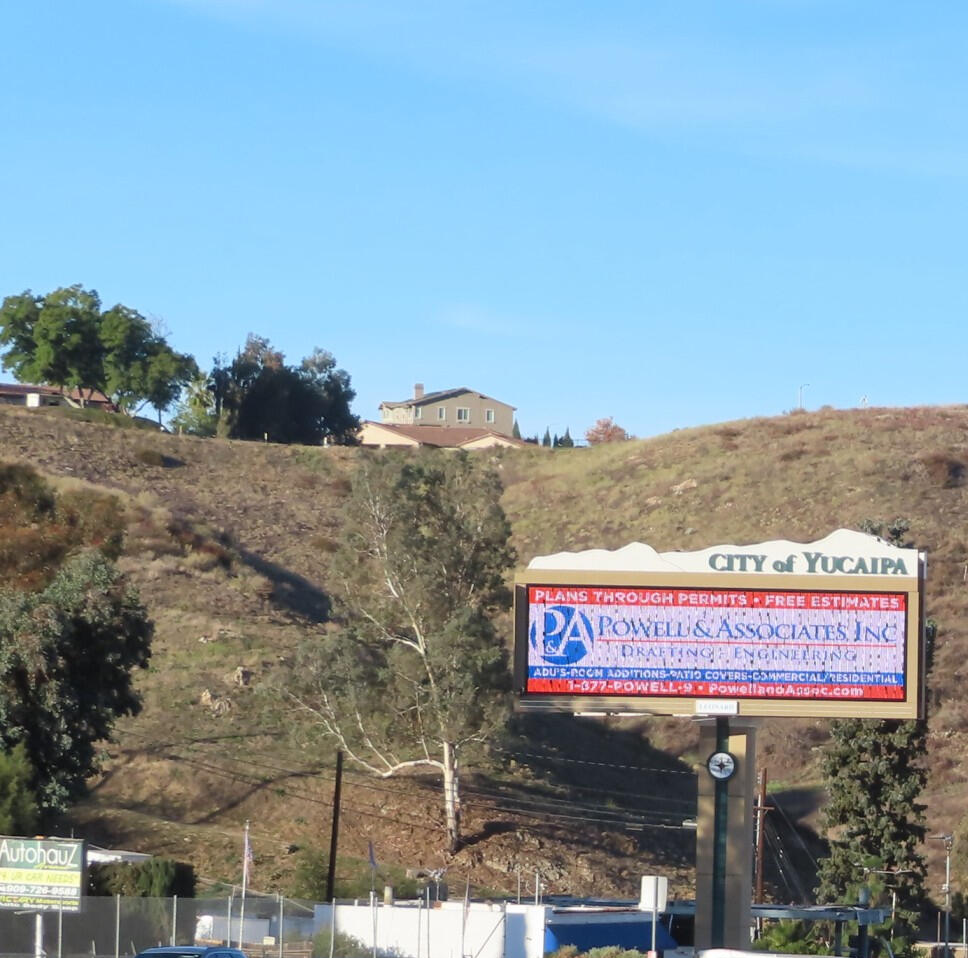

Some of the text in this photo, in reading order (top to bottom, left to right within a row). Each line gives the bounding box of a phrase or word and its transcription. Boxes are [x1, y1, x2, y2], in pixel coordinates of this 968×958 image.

[708, 551, 909, 575] CITY of YUCAIPA
[535, 590, 899, 609] PLANS THROUGH PERMITS FREE ESTIMATES
[693, 618, 712, 638] &
